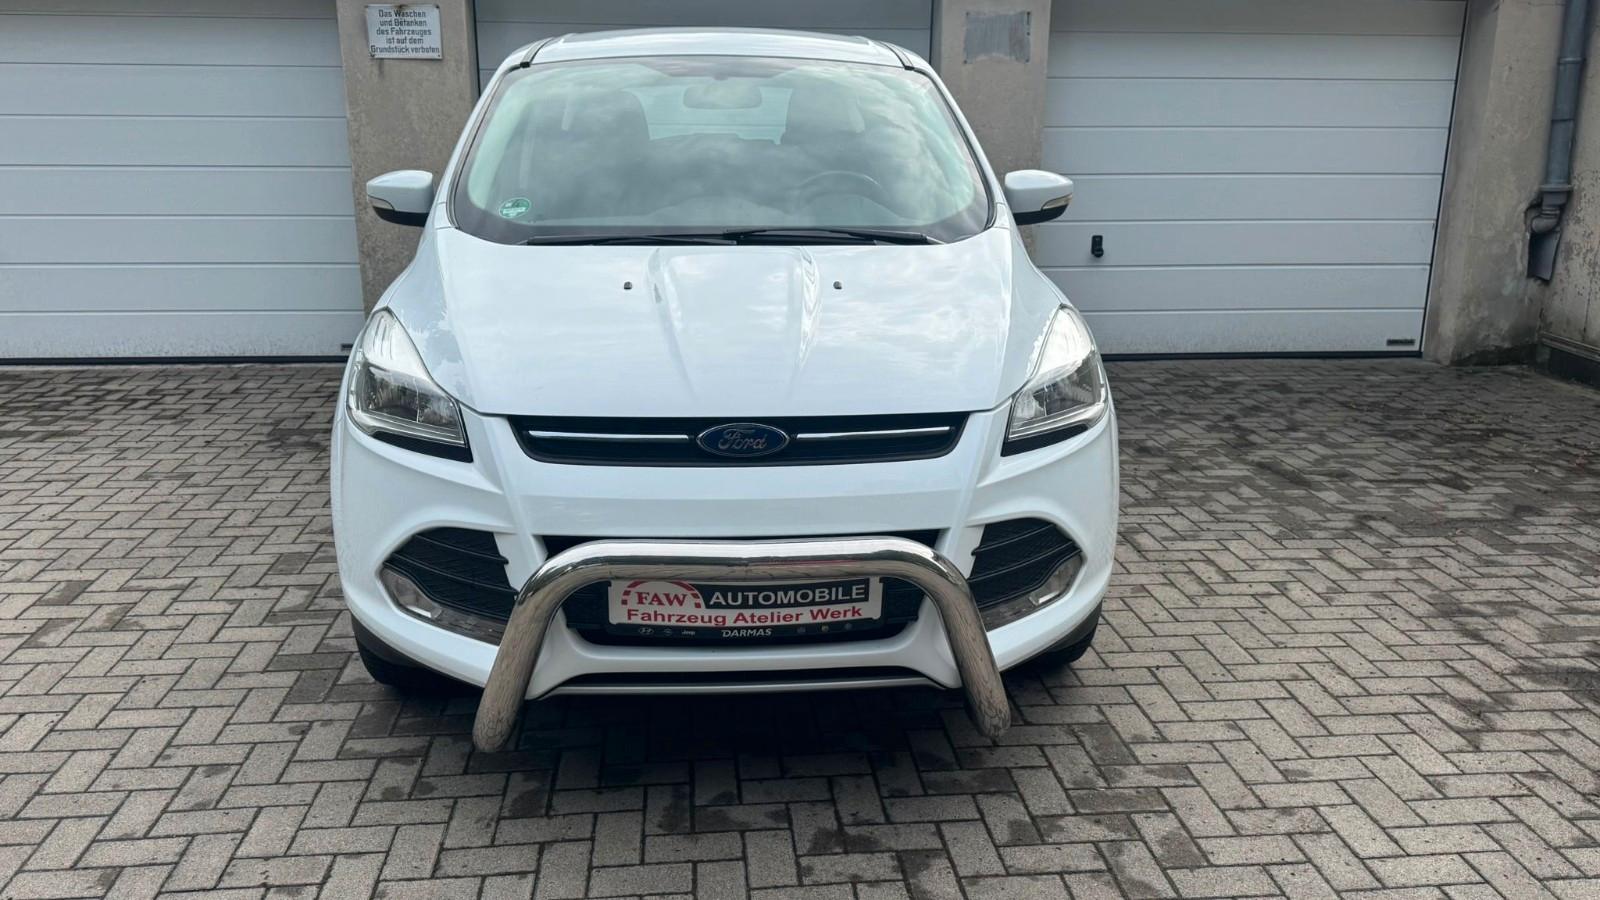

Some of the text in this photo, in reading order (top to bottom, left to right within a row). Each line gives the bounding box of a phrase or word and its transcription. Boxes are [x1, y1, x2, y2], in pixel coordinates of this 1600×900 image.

[378, 9, 427, 18] Das Waschen
[379, 18, 427, 27] und Betanken
[376, 27, 432, 37] des Fahrzeuges
[385, 36, 424, 45] ist auf dem
[370, 45, 410, 54] Grundstück
[717, 428, 768, 450] Ford
[635, 584, 866, 607] FAW AUTOMOBILE
[627, 606, 863, 626] Fahrzeug Atelier Werk
[720, 628, 773, 638] DARMAS
